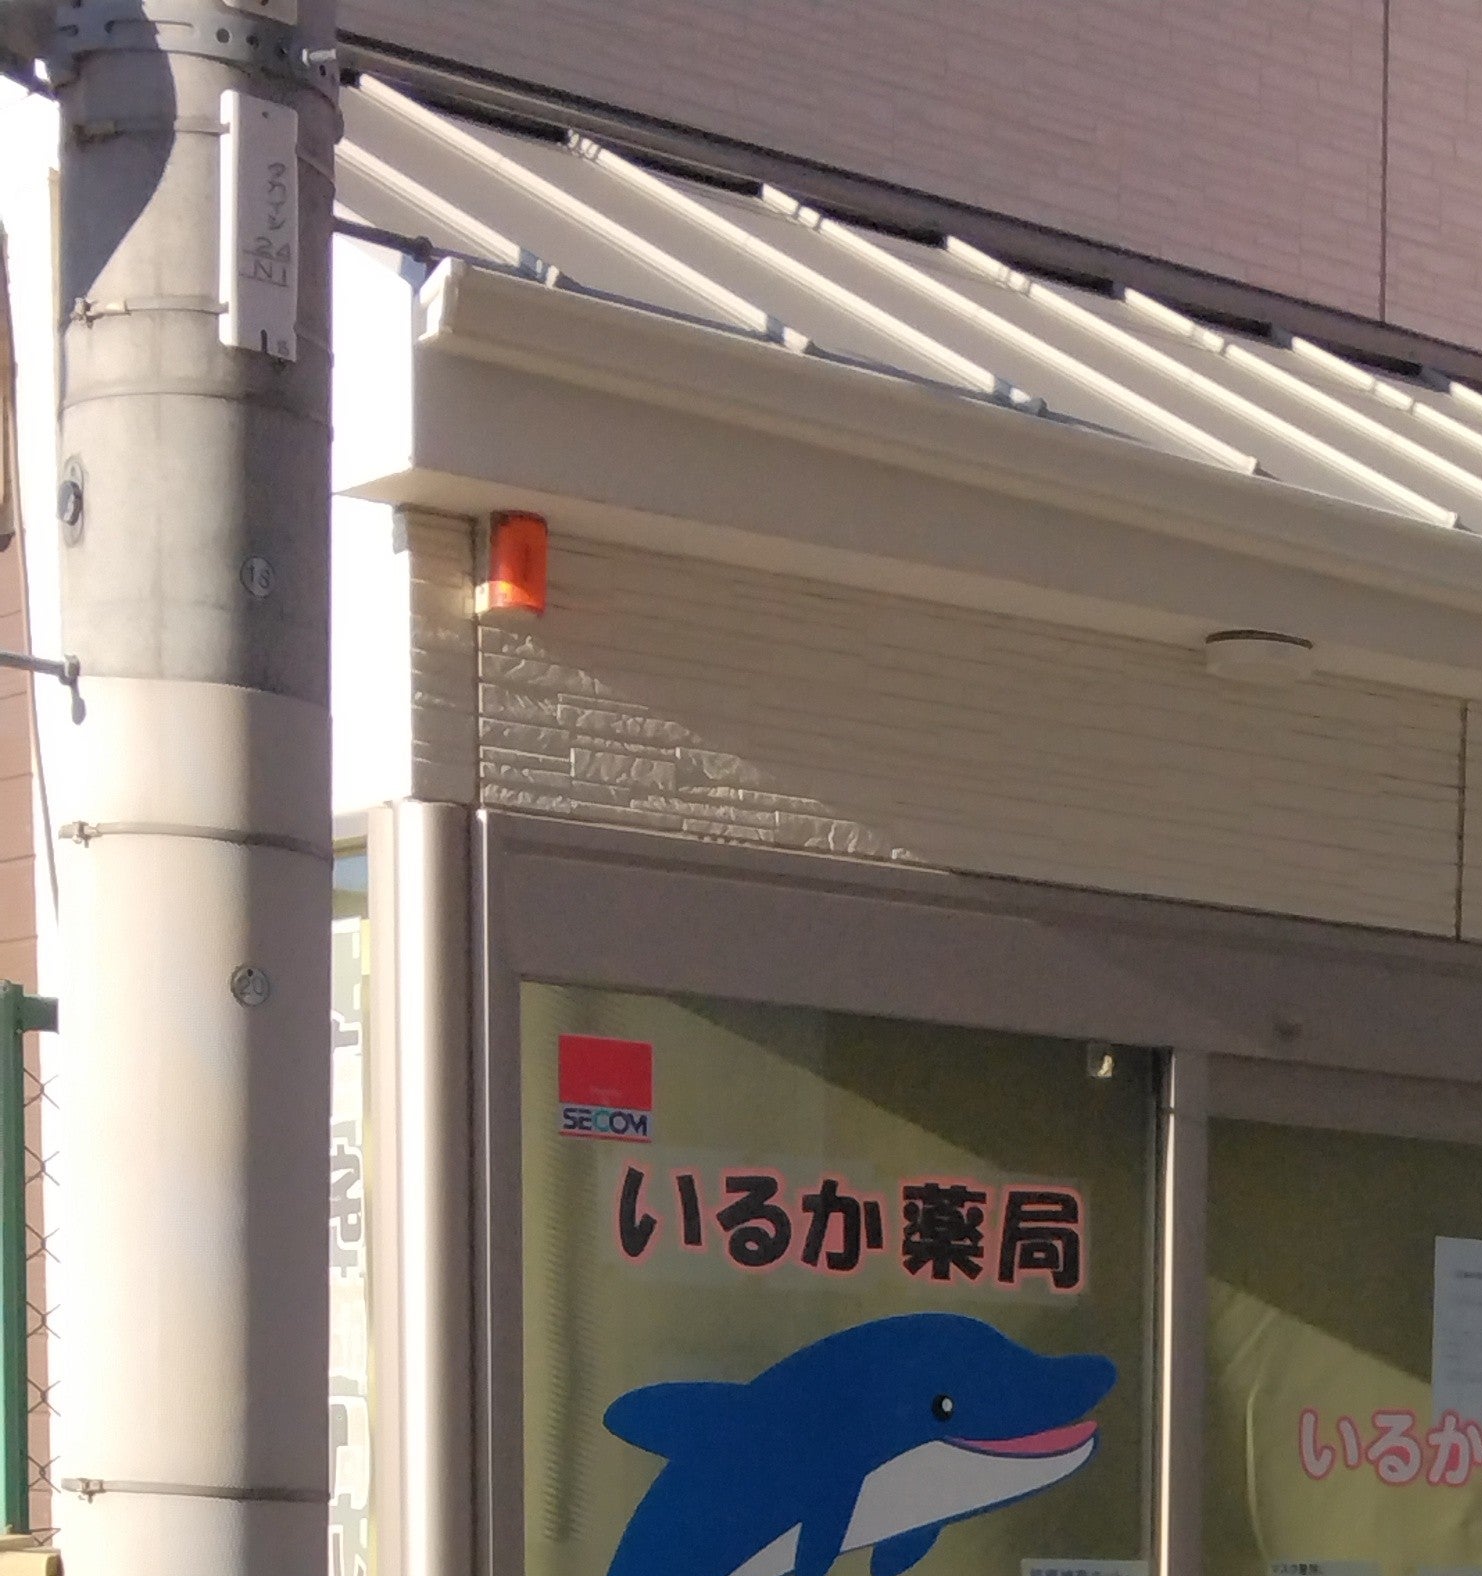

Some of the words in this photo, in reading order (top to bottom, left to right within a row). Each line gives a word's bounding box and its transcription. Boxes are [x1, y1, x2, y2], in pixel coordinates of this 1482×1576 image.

[562, 1106, 650, 1137] SECOM
[614, 1163, 1086, 1293] いるか薬局
